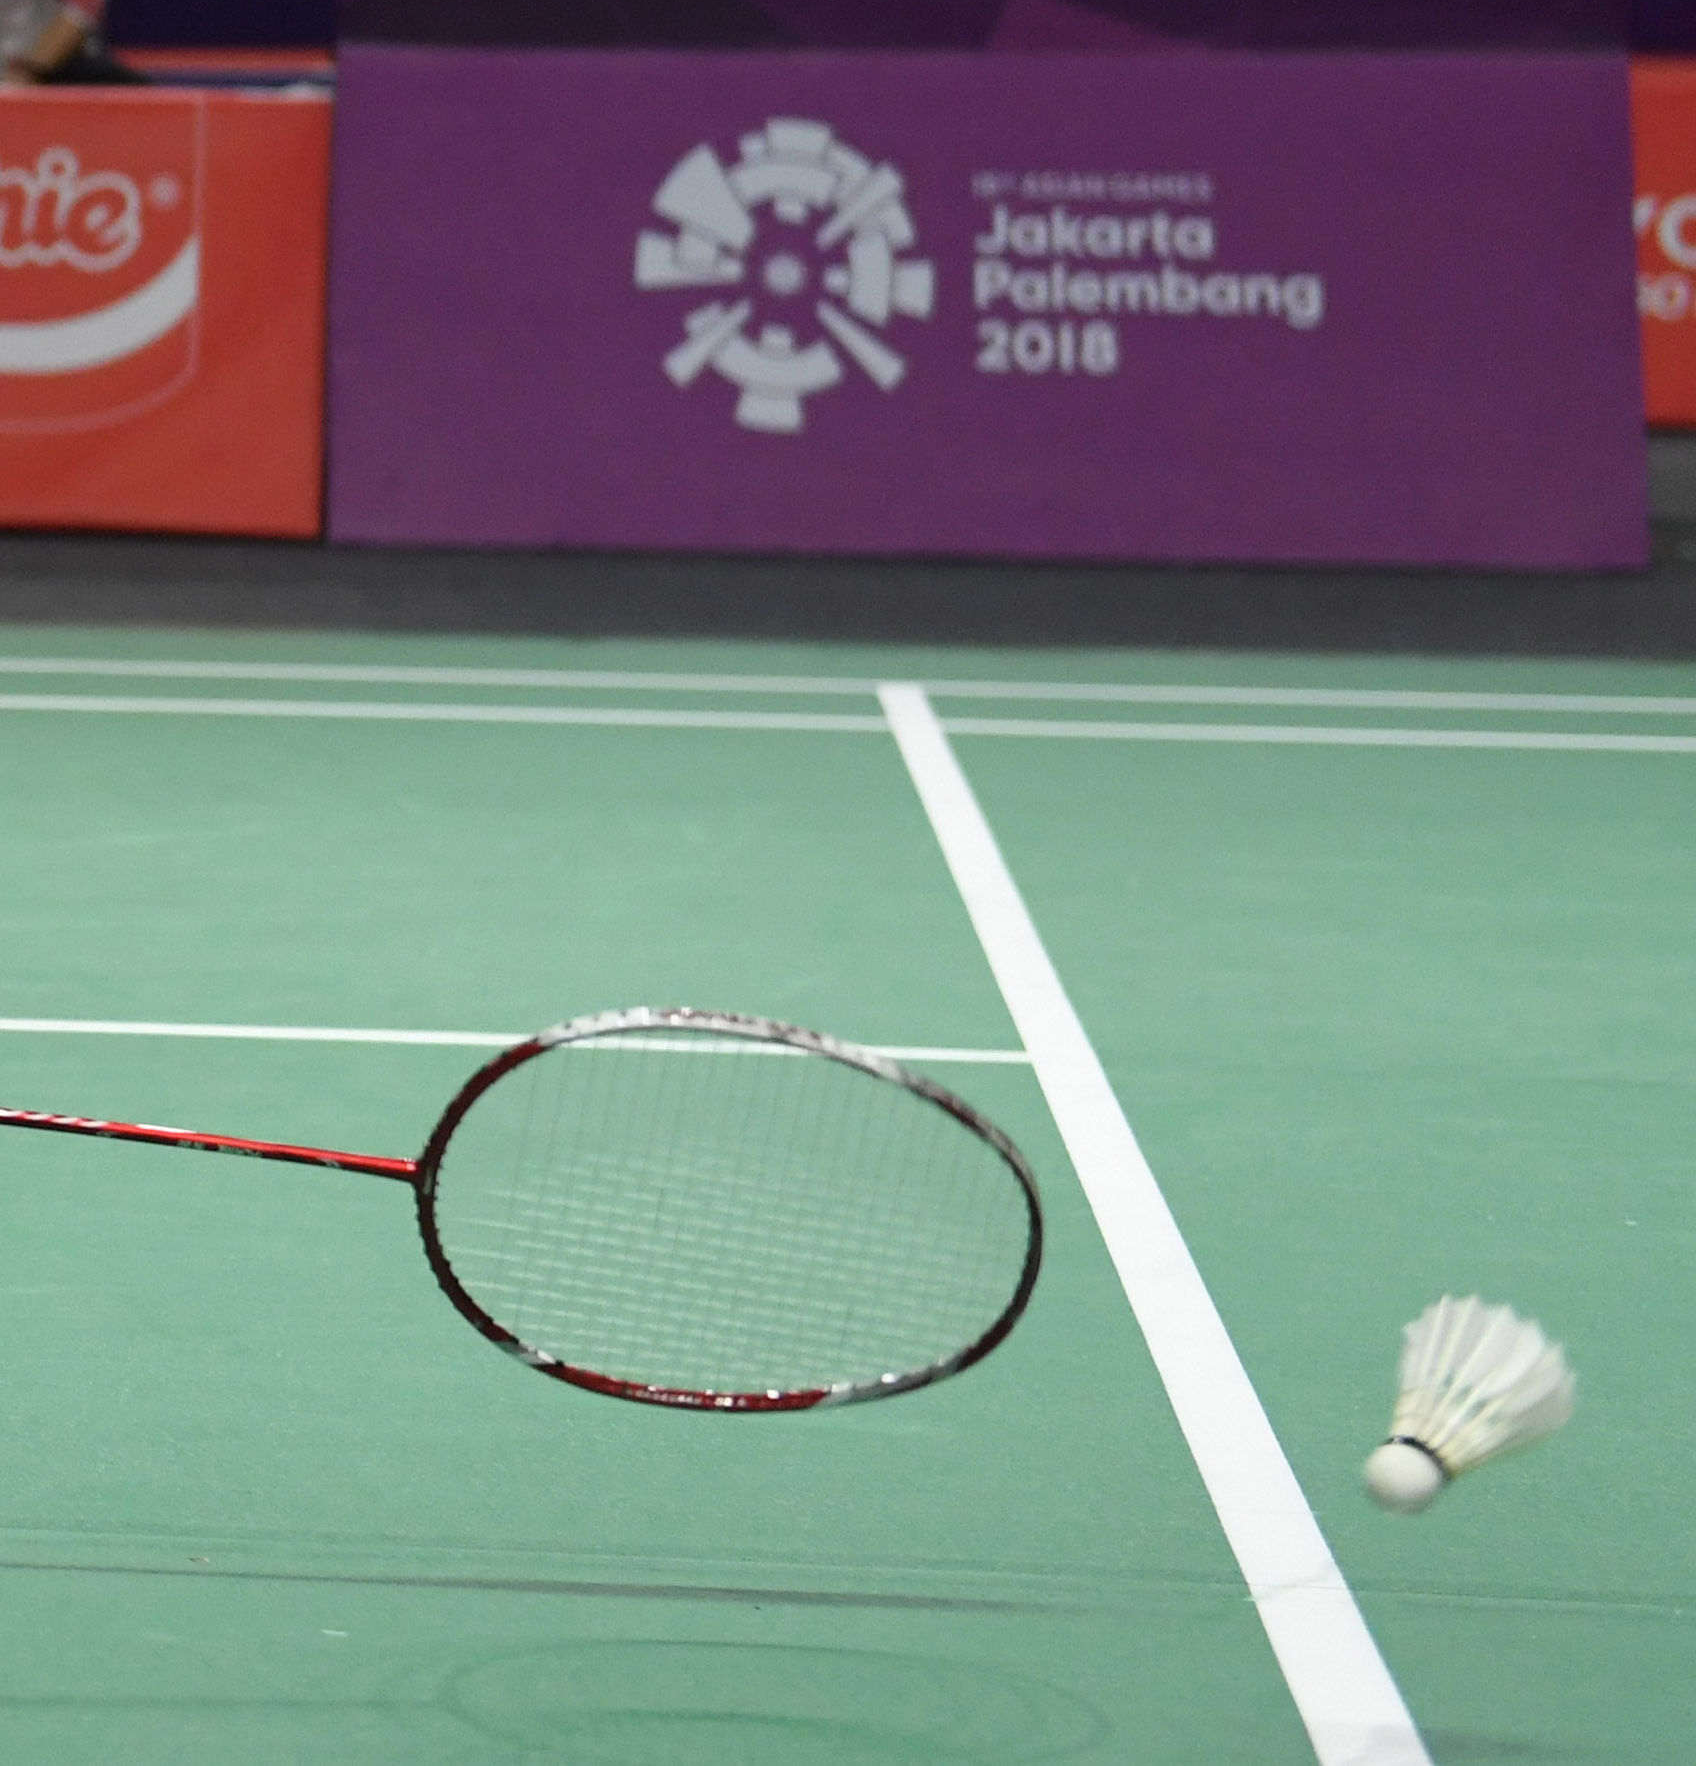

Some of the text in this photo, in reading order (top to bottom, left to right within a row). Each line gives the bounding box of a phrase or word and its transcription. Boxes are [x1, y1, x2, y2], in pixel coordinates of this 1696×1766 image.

[973, 202, 1216, 260] Jakarta
[973, 256, 1325, 332] Palembang
[974, 316, 1120, 376] 2018
